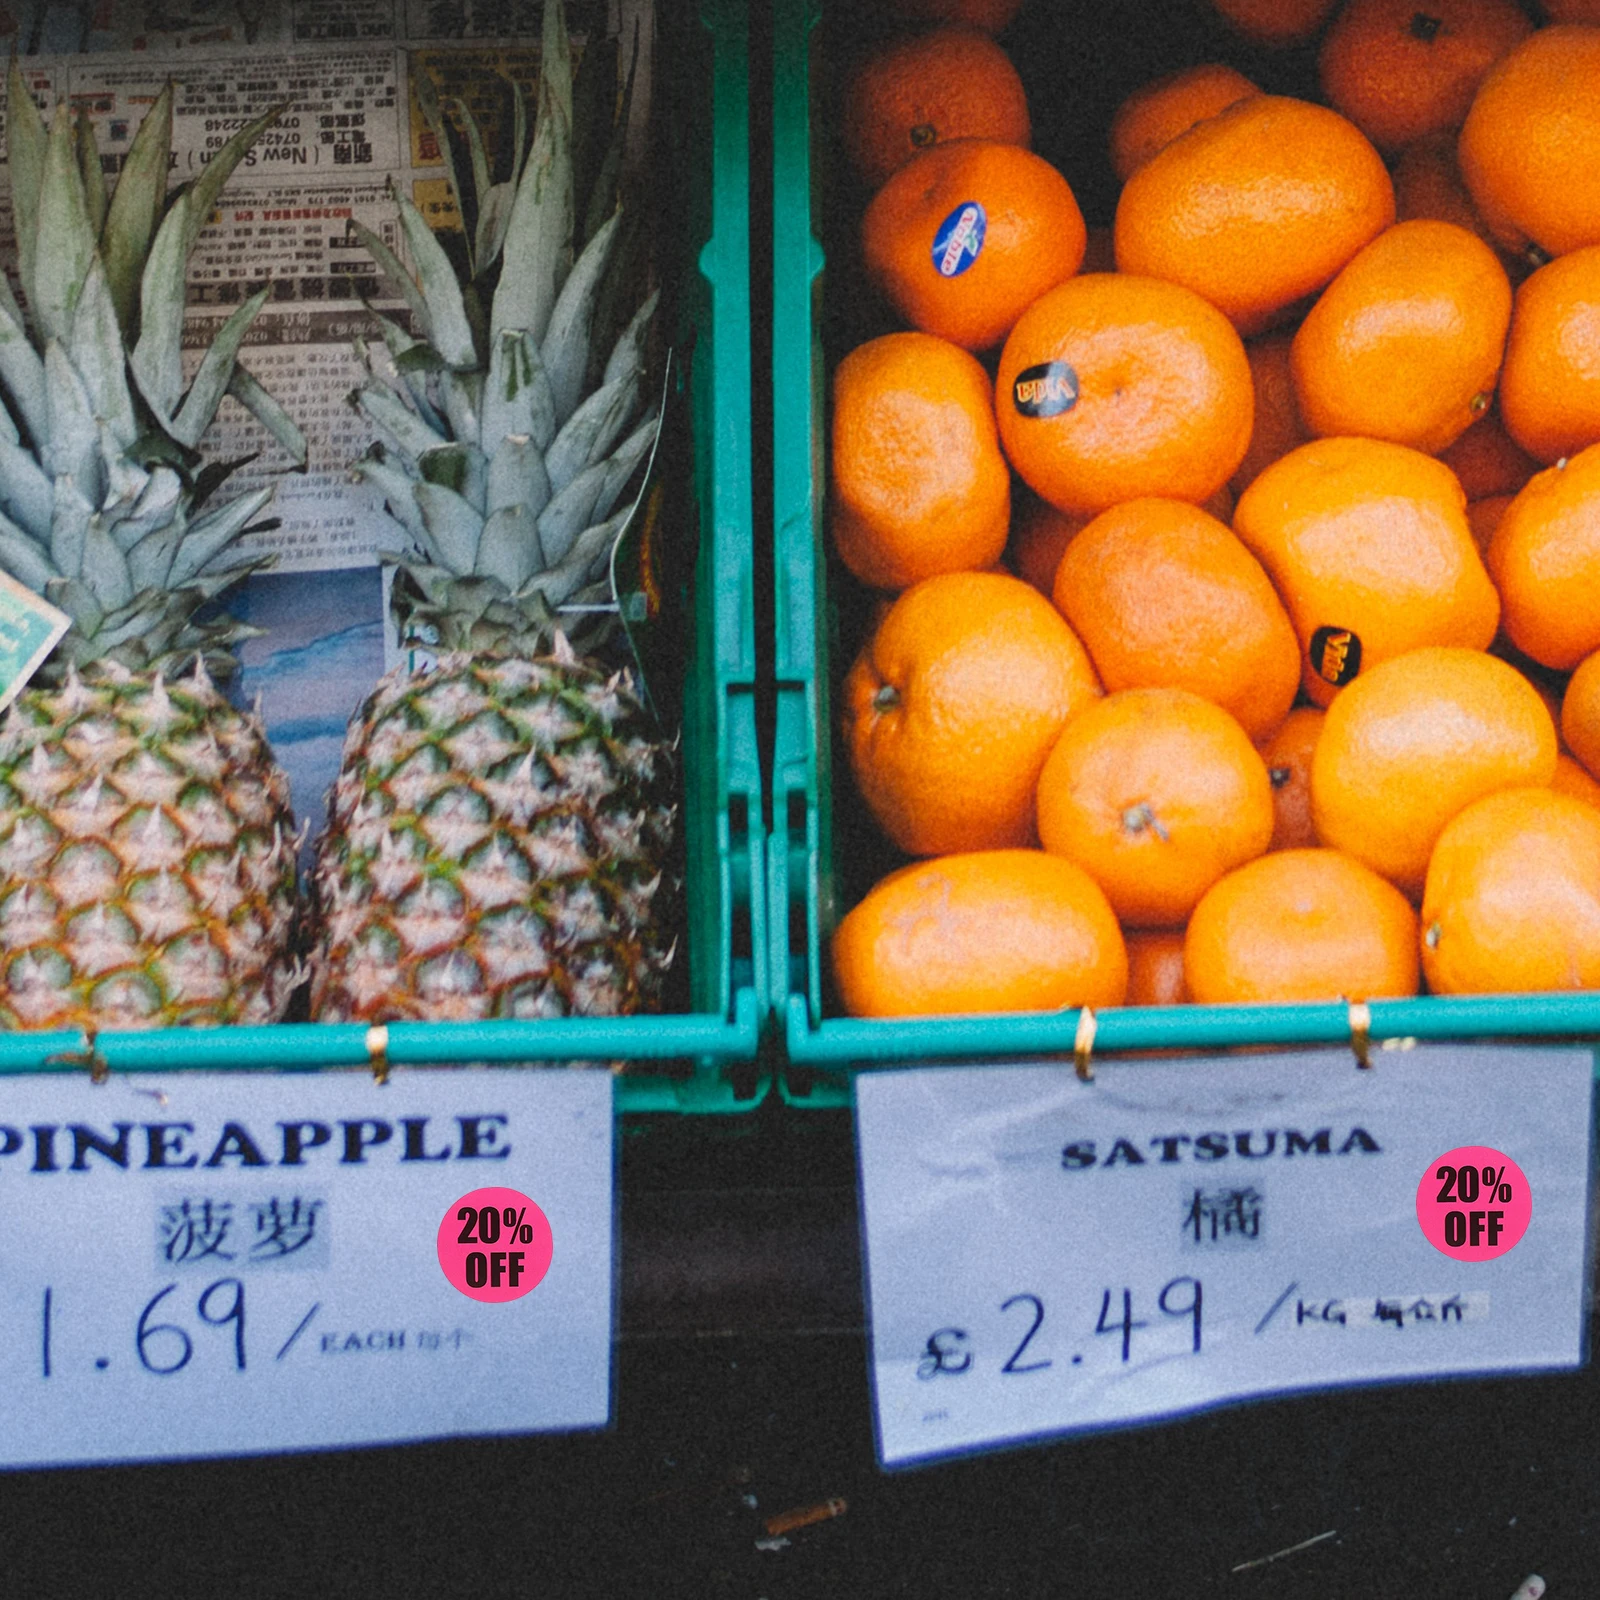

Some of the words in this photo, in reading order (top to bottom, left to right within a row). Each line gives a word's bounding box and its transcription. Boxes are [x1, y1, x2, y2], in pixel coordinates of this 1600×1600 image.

[1060, 1124, 1384, 1172] SATSUMA
[1436, 1165, 1513, 1205] 20%
[457, 1206, 534, 1246] 20%
[1443, 1211, 1505, 1248] OFF
[465, 1252, 526, 1288] OFF
